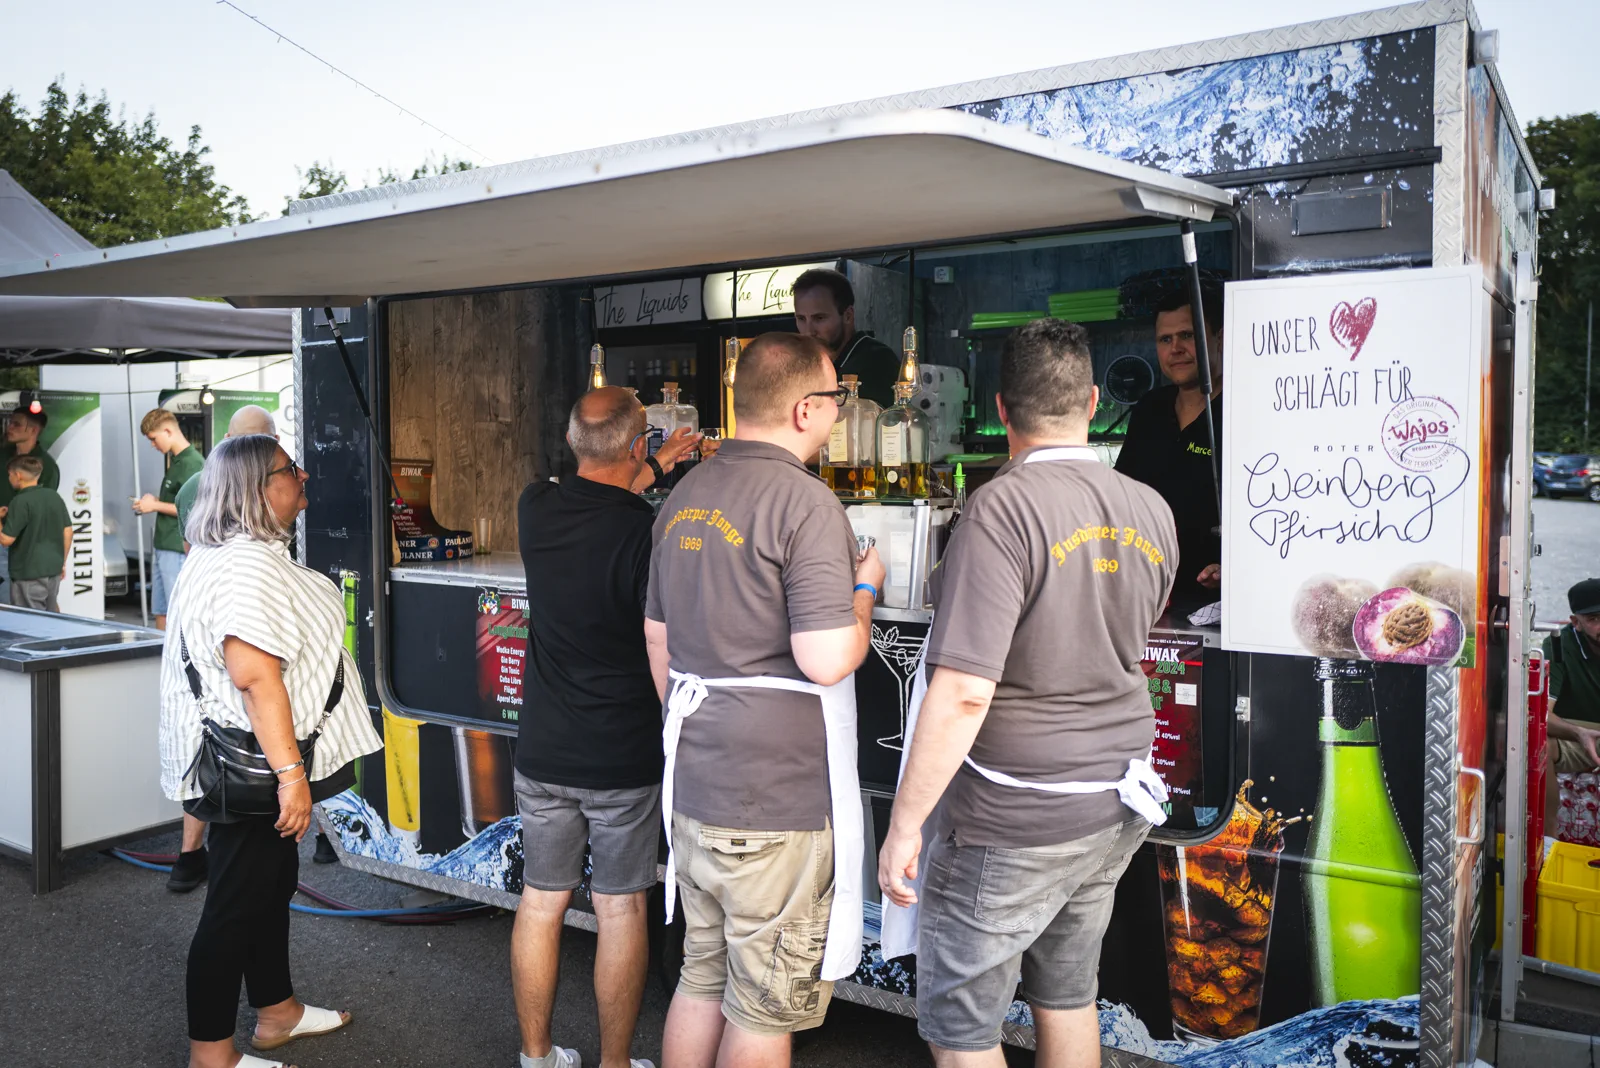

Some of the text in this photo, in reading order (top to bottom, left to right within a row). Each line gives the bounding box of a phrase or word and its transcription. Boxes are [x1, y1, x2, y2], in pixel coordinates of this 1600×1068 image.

[595, 278, 690, 328] The Liquids
[1252, 316, 1320, 356] UNSER
[1273, 360, 1415, 411] SCHLÄGT FÜR
[1313, 444, 1374, 452] ROTER
[400, 467, 423, 476] BIWAK
[1243, 445, 1470, 527] Weinberg
[679, 535, 703, 551] 1969
[706, 508, 745, 547] Jonge
[1250, 509, 1413, 559] Pfirsich
[73, 509, 93, 596] VELTINS
[1156, 661, 1185, 675] 2024
[502, 709, 519, 720] 6 WM
[1160, 802, 1172, 816] M
